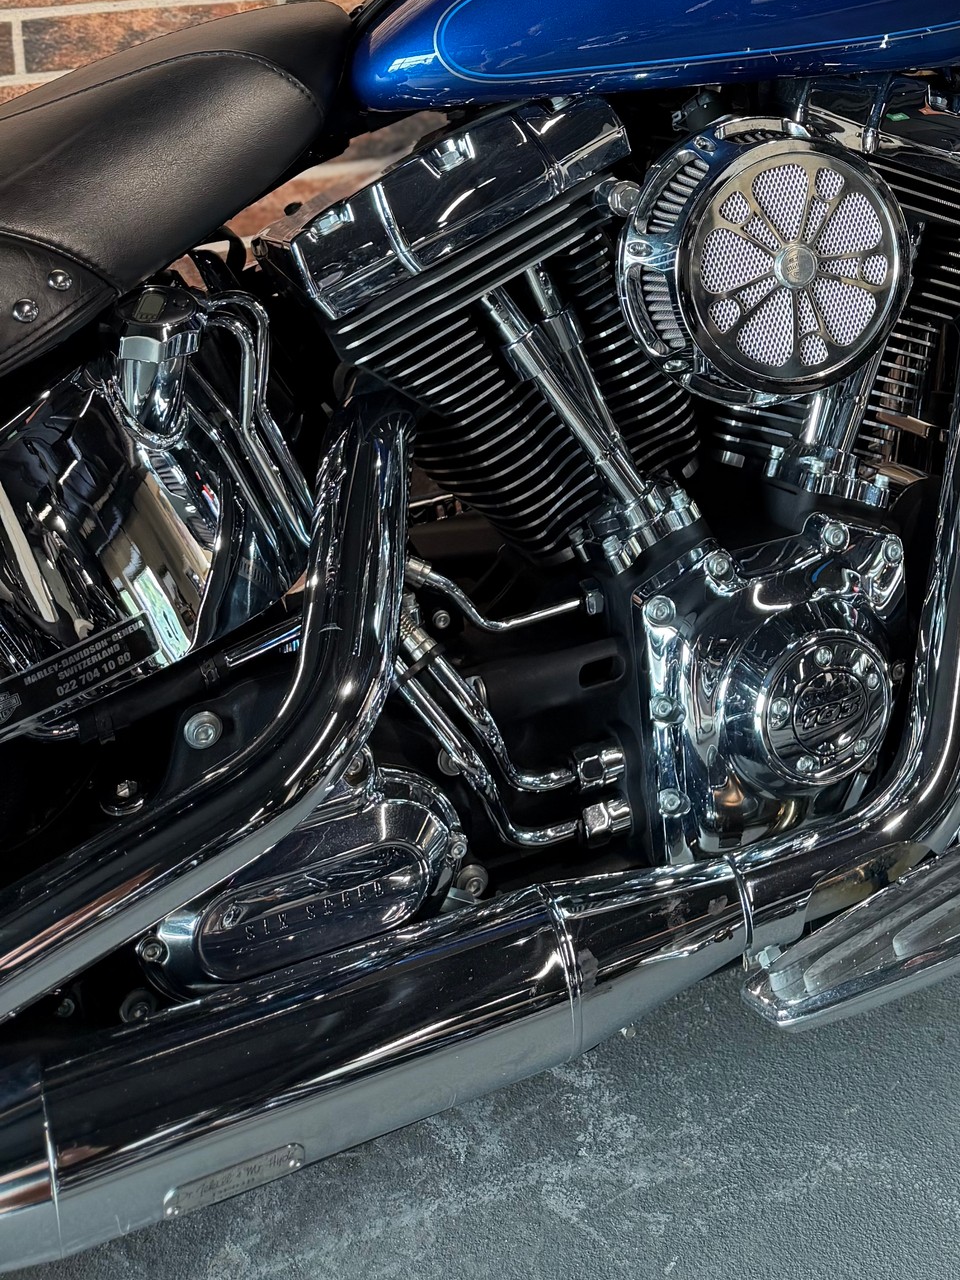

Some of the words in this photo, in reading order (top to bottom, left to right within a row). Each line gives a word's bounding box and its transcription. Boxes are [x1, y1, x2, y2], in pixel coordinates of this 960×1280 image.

[111, 621, 145, 642] GENEVA
[55, 679, 79, 697] 022
[79, 670, 101, 686] 704
[101, 660, 116, 674] 10
[117, 651, 132, 666] 80
[57, 643, 121, 681] SWITZERLAND
[244, 911, 290, 941] SIX
